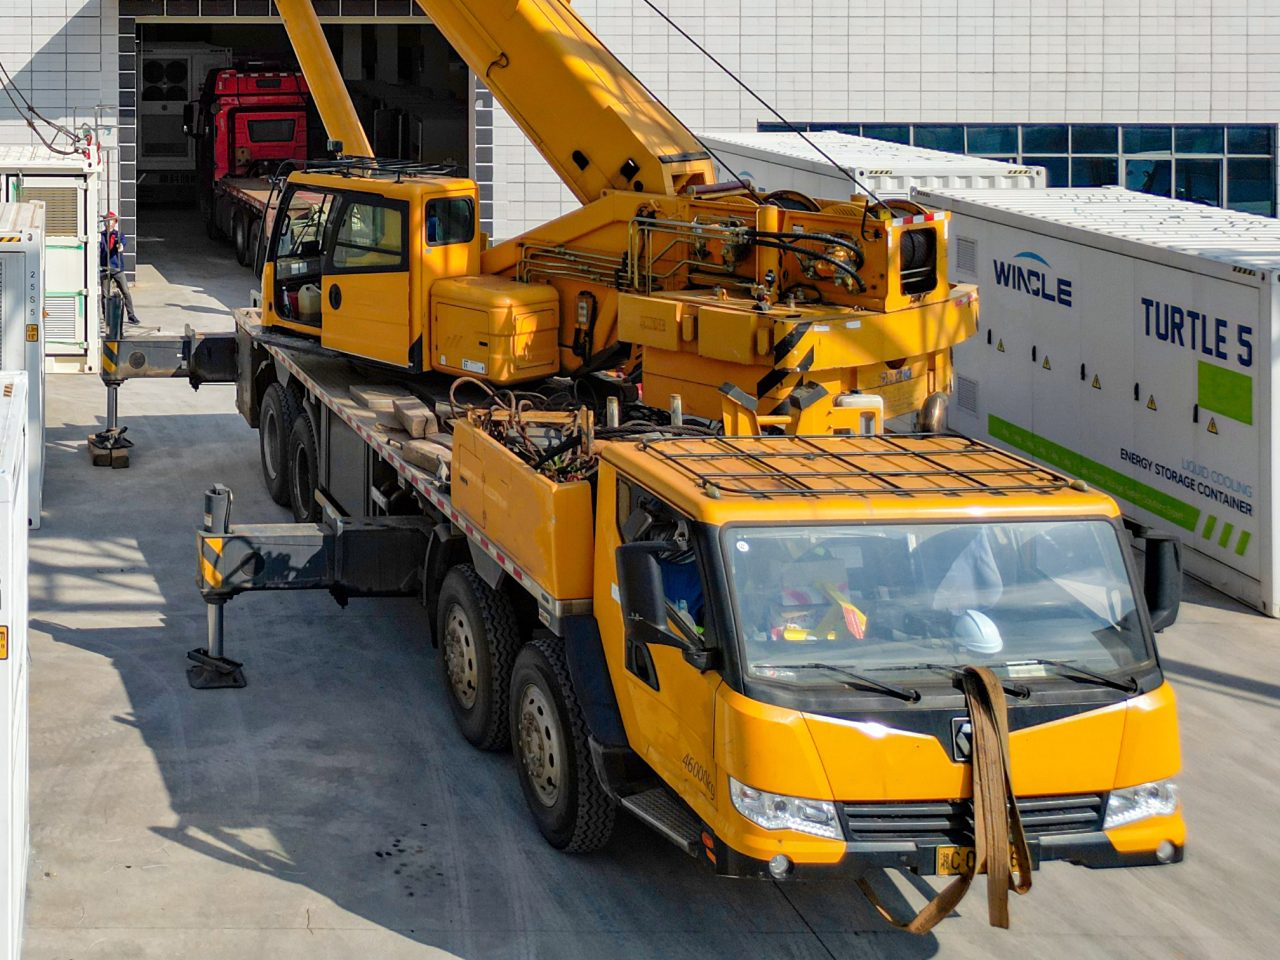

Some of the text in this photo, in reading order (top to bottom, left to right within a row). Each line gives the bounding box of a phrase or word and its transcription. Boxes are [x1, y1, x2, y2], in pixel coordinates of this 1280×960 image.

[993, 259, 1072, 308] WINCLE
[1141, 297, 1253, 368] TURTLE 5
[1120, 447, 1153, 473] ENERGY
[1154, 462, 1196, 493] STORAGE
[1197, 481, 1254, 517] CONTAINER
[1182, 456, 1208, 480] LIQUID
[1210, 469, 1253, 498] COOLING
[682, 753, 715, 799] 46000kg
